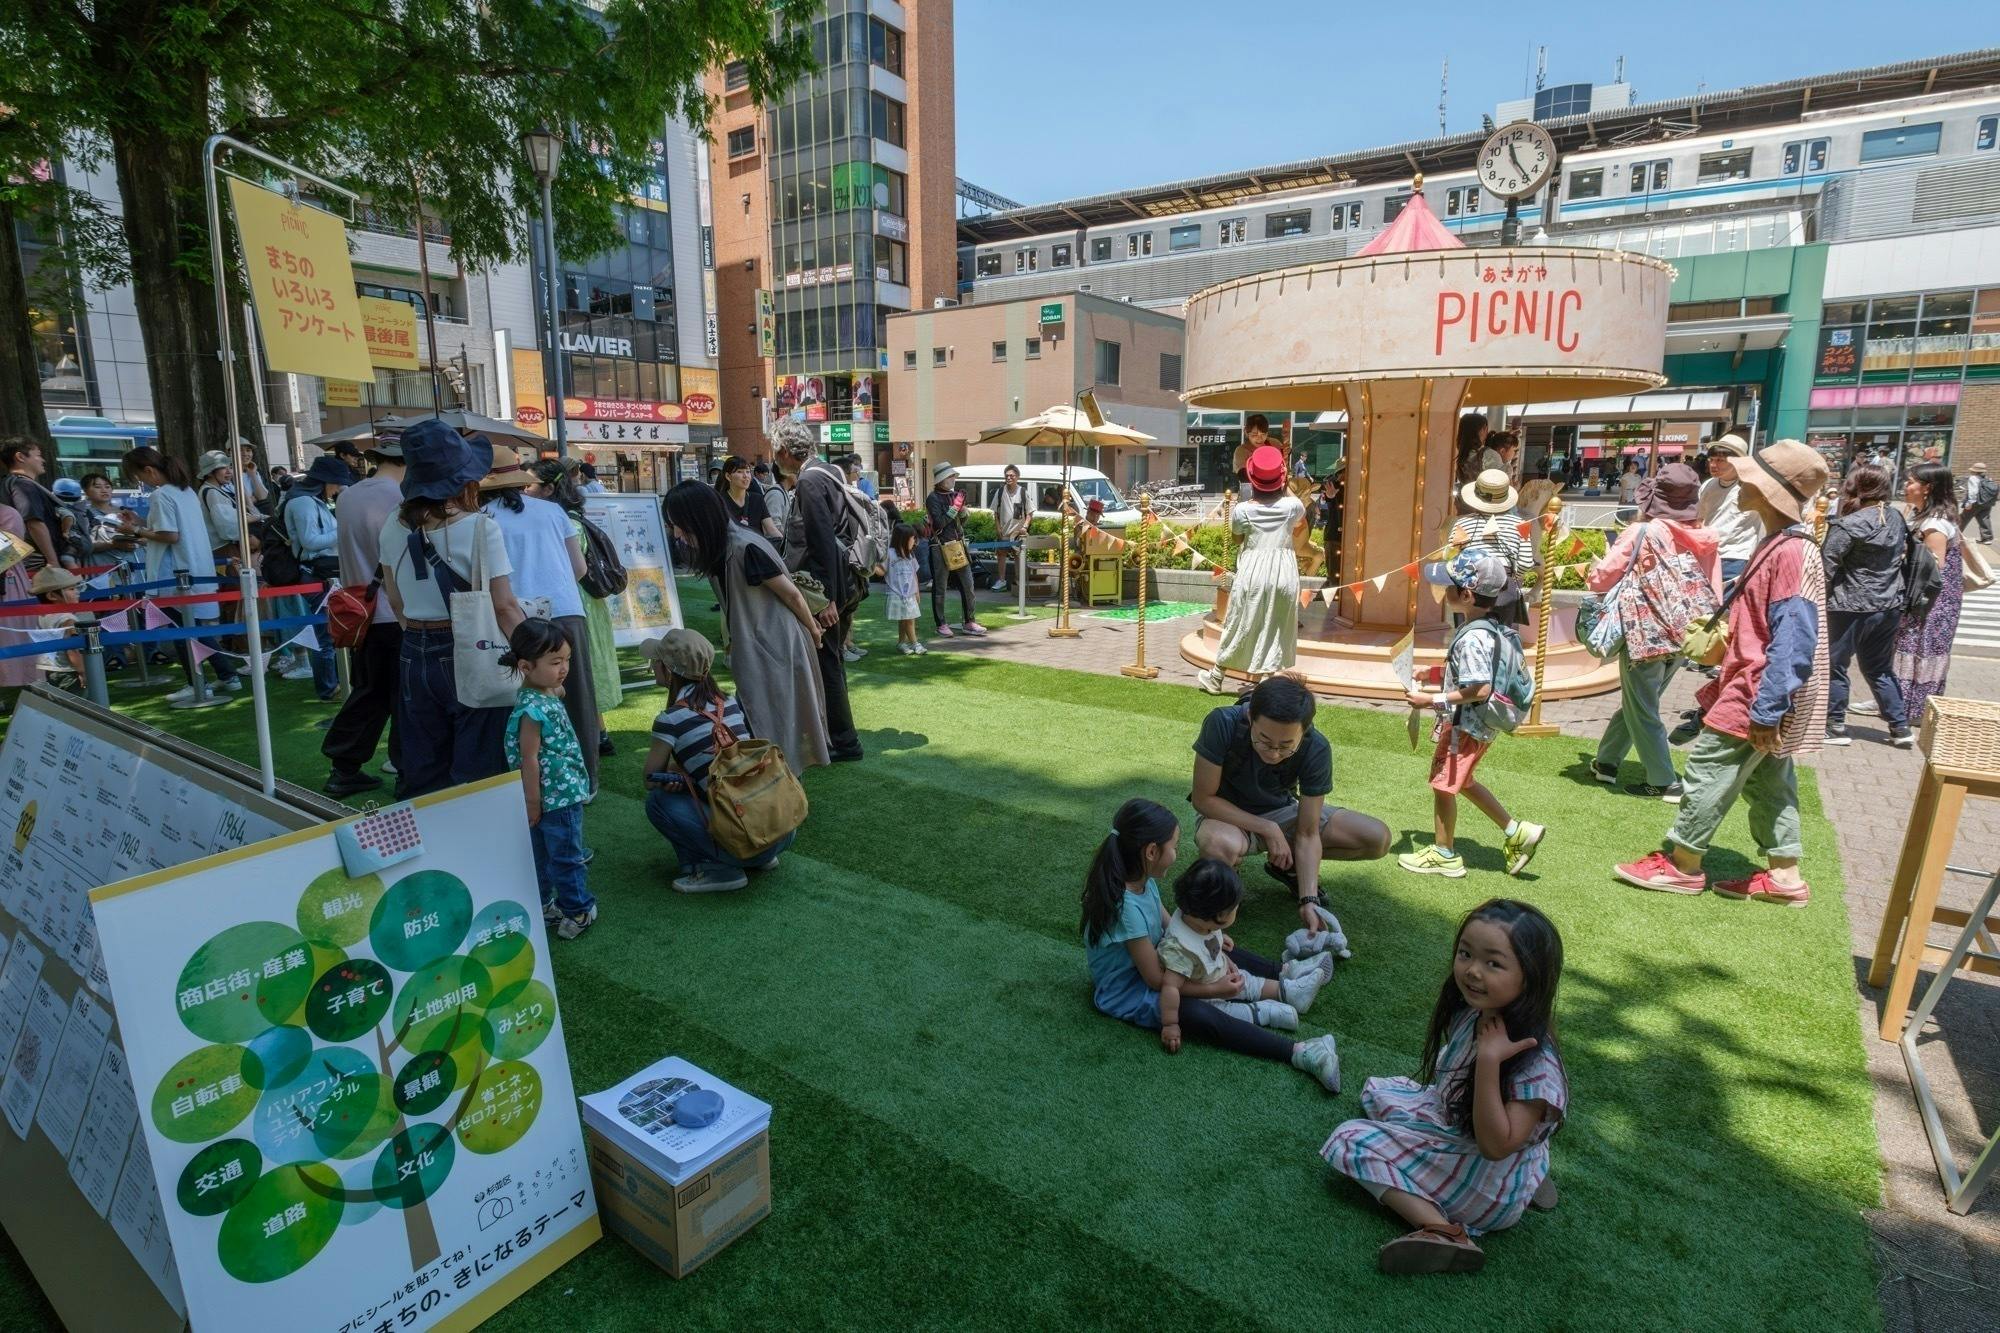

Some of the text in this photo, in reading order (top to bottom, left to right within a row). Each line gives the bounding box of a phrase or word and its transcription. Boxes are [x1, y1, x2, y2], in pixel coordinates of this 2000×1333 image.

[1499, 137, 1508, 146] 11
[1511, 130, 1523, 140] 12
[1527, 133, 1532, 141] 1
[1534, 140, 1542, 149] 2
[1486, 160, 1493, 169] 9
[1489, 148, 1501, 157] 10
[1537, 152, 1545, 161] 3
[1489, 171, 1496, 180] 8
[1498, 178, 1505, 187] 7
[1531, 165, 1539, 174] 4
[1508, 180, 1516, 189] 6
[281, 213, 309, 240] PICNIC
[265, 246, 314, 279] まちの
[1483, 265, 1548, 284] あさがや
[272, 277, 335, 310] いろいろ
[279, 308, 355, 342] アンケート
[363, 325, 410, 347] 最後尾
[1435, 290, 1582, 356] PICNIC
[547, 330, 632, 357] KLAVIER
[707, 320, 717, 355] 富士そば
[599, 423, 660, 440] 富士そば
[712, 440, 728, 448] BAR
[1189, 435, 1226, 444] COFFEE
[1665, 434, 1688, 442] KING
[219, 810, 247, 845] 1964
[118, 831, 141, 861] 1949
[322, 892, 364, 919] 観光
[404, 912, 440, 939] 防災
[477, 915, 525, 947] 空き家
[179, 948, 307, 1011] 商店街・産業
[326, 979, 384, 1014] 子育て
[409, 982, 478, 1026] 土地利用
[498, 1003, 543, 1034] みどり
[105, 1051, 121, 1076] 1964
[171, 1073, 244, 1119] 自転車
[404, 1069, 441, 1100] 景観
[271, 1081, 360, 1132] ユニバーサル
[458, 1083, 533, 1131] ゼロカーボン
[501, 1099, 535, 1125] シティ
[273, 1110, 333, 1148] デザイン
[194, 1158, 244, 1197] 交通
[398, 1150, 434, 1181] 文化
[486, 1174, 512, 1196] 杉並区
[262, 1201, 307, 1238] 道路
[373, 1190, 586, 1333] まちの、きになるテーマ
